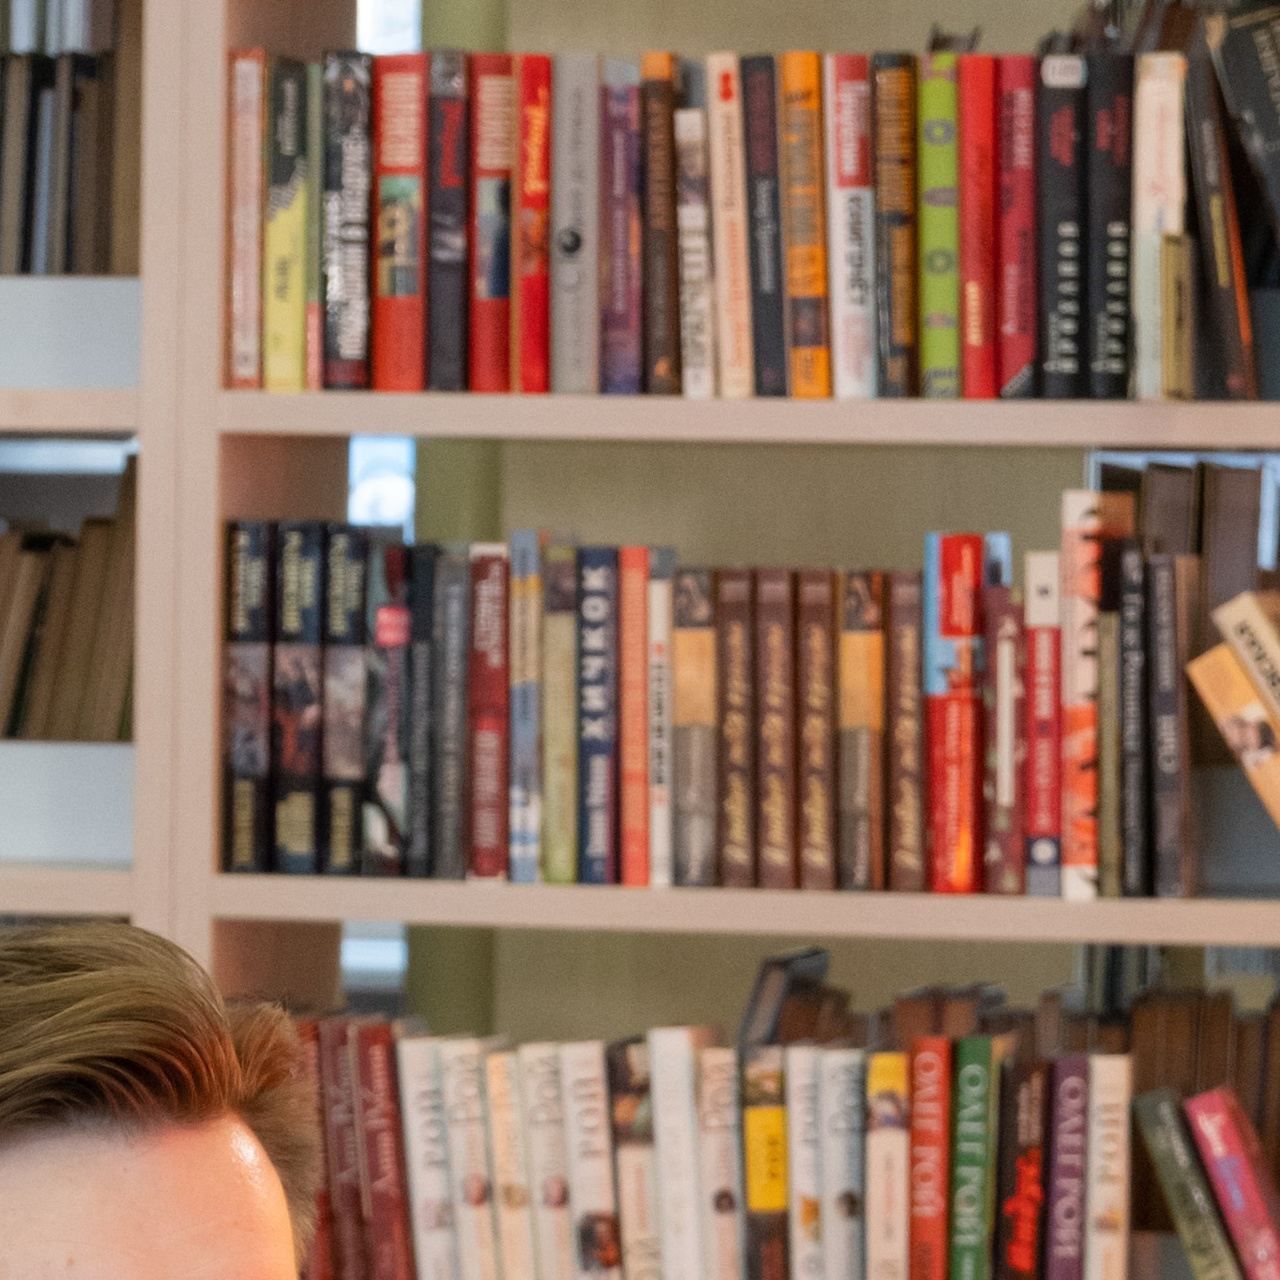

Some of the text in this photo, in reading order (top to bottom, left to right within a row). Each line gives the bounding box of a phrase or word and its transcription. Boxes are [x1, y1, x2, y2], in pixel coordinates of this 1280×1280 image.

[582, 566, 608, 741] ХИЧКОК
[451, 1053, 484, 1126] Рой
[527, 1054, 562, 1130] Рой
[700, 1060, 734, 1130] Рой
[828, 1063, 866, 1136] Рой
[909, 1051, 943, 1218] ОЛЕГ РОЙ
[952, 1063, 986, 1245] ОЛЕГ РОЙ
[1053, 1076, 1086, 1258] ОЛЕГ РОЙ
